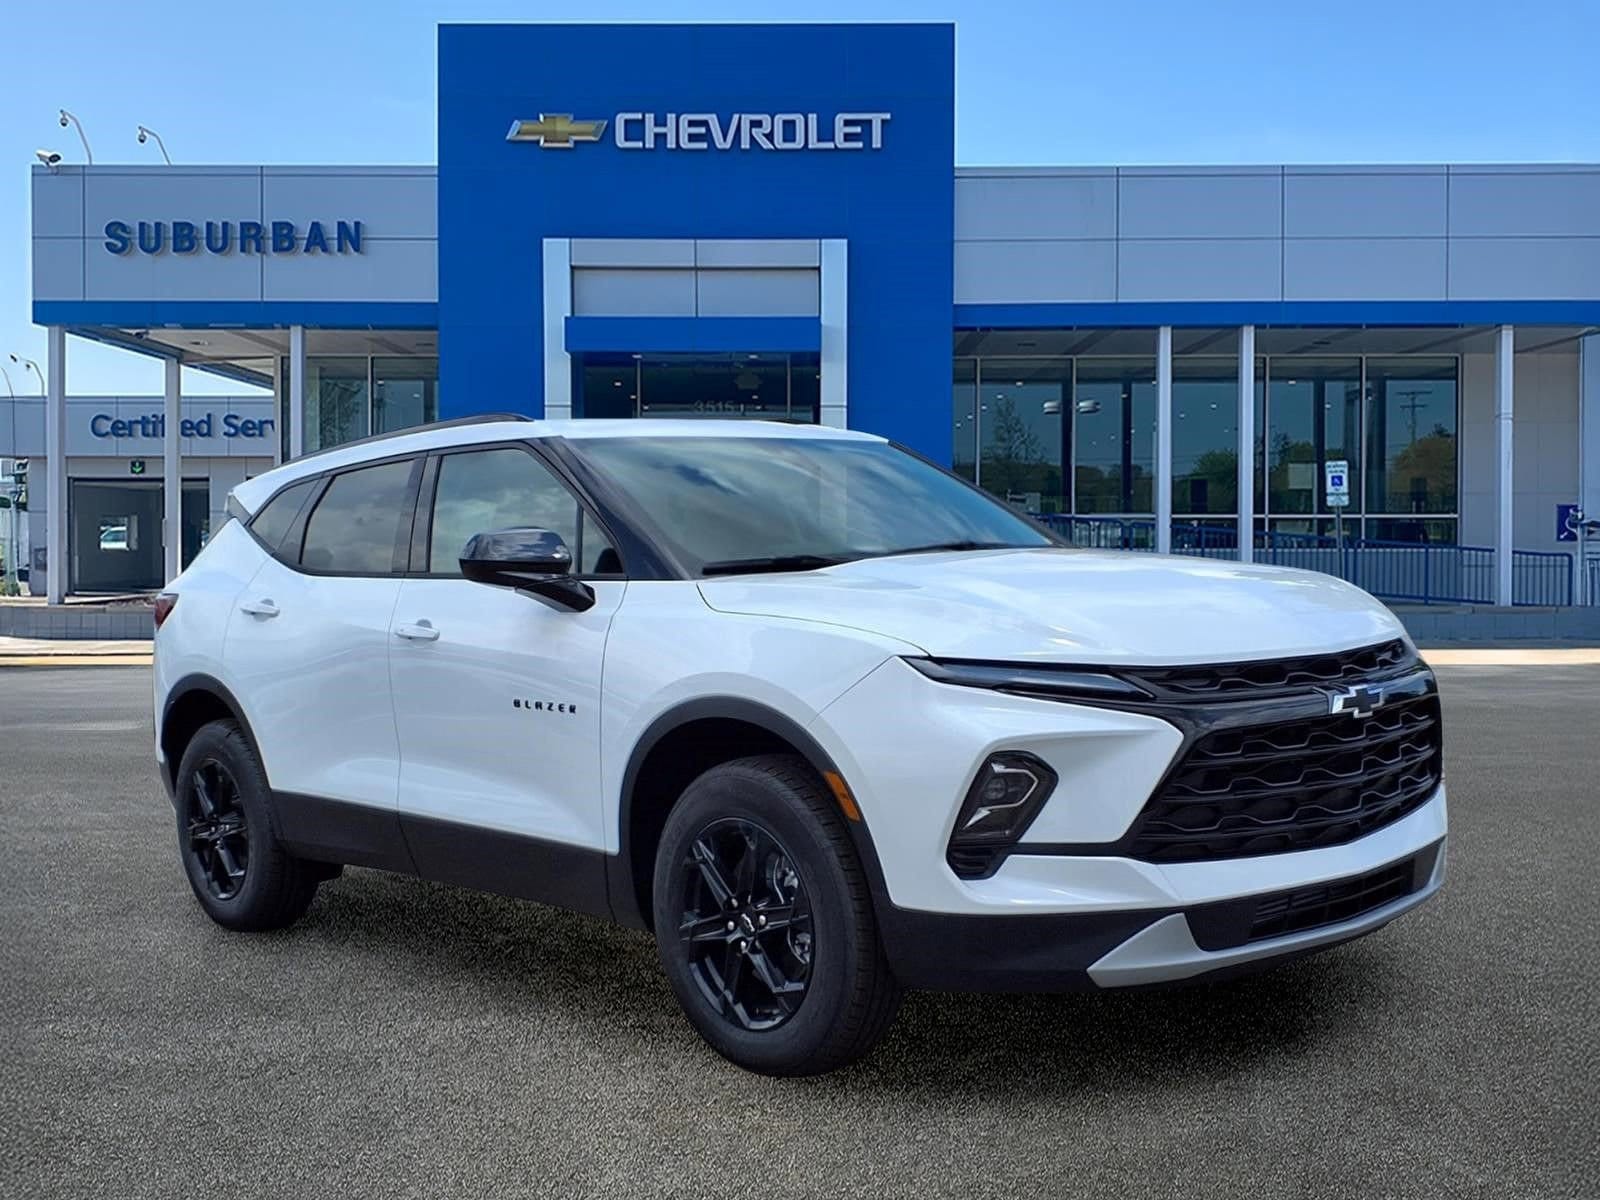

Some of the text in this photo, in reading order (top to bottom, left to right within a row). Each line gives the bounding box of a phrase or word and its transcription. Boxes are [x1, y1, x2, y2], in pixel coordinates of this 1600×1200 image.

[615, 112, 891, 150] CHEVROLET
[104, 220, 362, 254] SUBURBAN
[90, 413, 212, 437] Certifed
[513, 698, 577, 714] BLAZER
